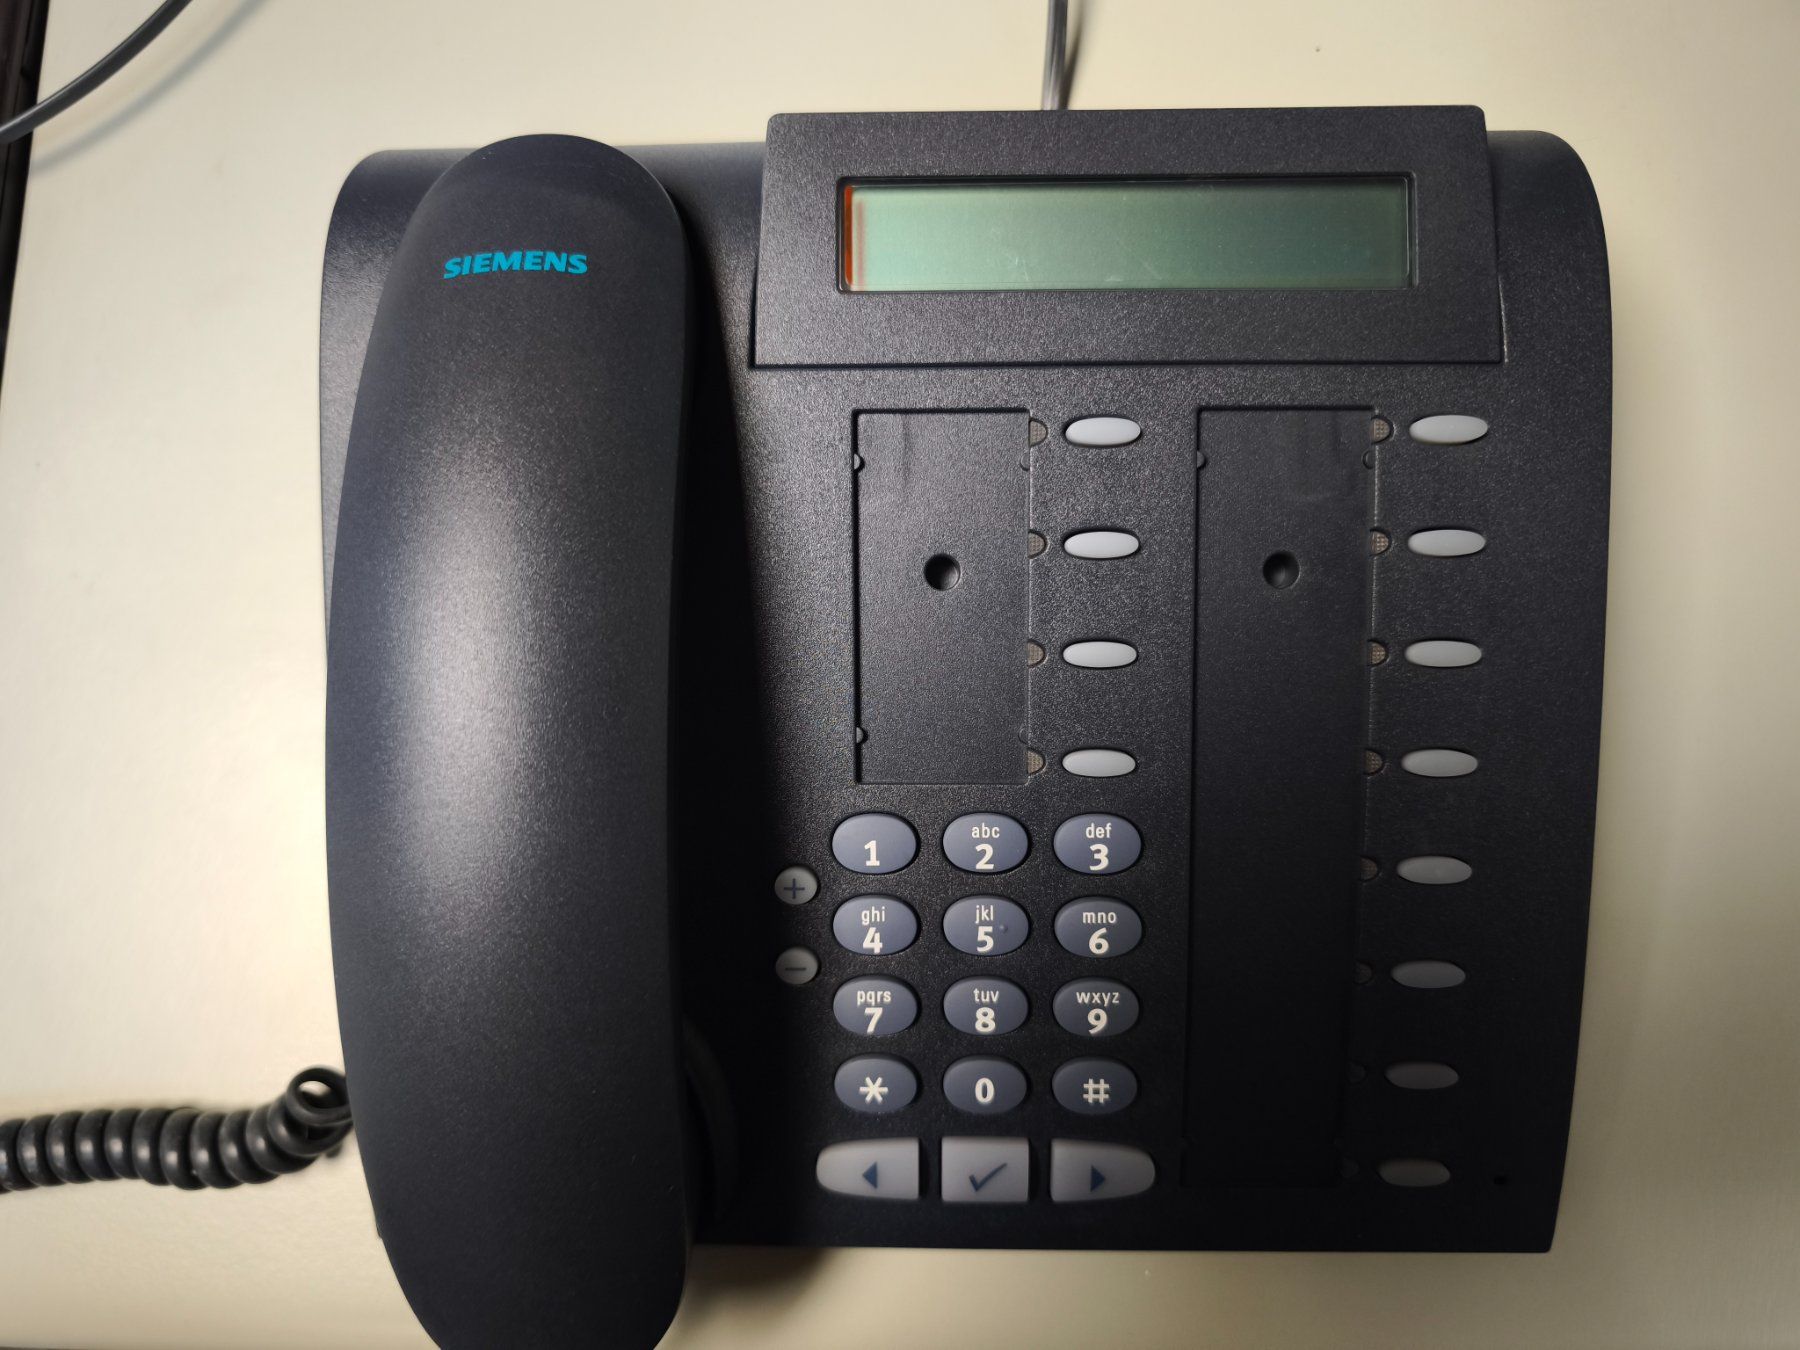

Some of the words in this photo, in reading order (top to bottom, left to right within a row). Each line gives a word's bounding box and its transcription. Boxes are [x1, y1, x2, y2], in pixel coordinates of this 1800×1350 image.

[443, 250, 589, 280] SIEMENS
[971, 821, 1001, 840] abc
[1085, 821, 1113, 840] def
[863, 839, 881, 867] 1
[975, 843, 995, 870] 2
[1089, 843, 1109, 871] 3
[860, 905, 887, 927] ghi
[974, 904, 995, 924] jkl
[1082, 911, 1117, 925] mno
[862, 926, 883, 954] 4
[976, 925, 994, 953] 5
[1088, 927, 1110, 955] 6
[856, 989, 892, 1007] pqrs
[973, 987, 1000, 1003] tuv
[1076, 990, 1120, 1007] wxyz
[863, 1007, 884, 1033] 7
[974, 1006, 996, 1033] 8
[1086, 1008, 1108, 1035] 9
[974, 1077, 995, 1104] 0
